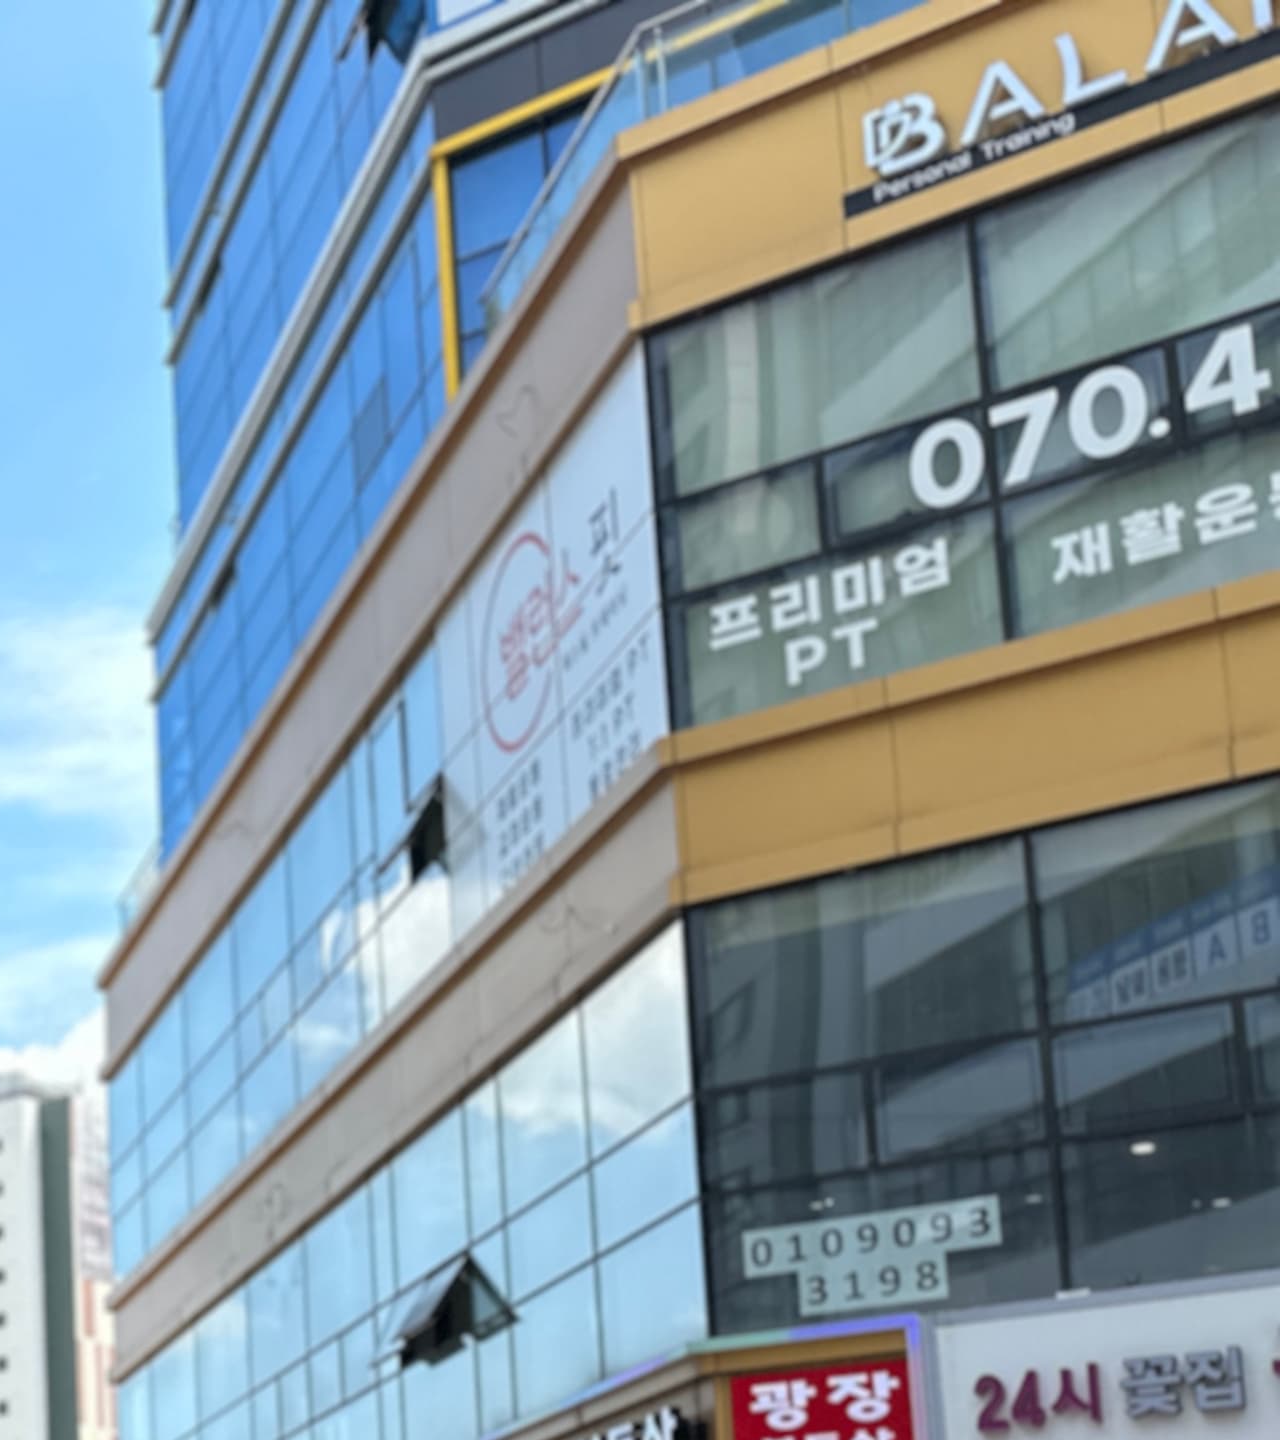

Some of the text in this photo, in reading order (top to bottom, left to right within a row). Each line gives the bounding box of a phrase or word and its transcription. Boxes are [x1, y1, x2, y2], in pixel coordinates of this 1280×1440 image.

[873, 112, 1077, 203] Personal Training
[908, 322, 1272, 509] 070.4
[709, 537, 951, 651] 프리미엄
[785, 618, 878, 686] PT
[807, 1261, 940, 1306] 3198
[749, 1369, 900, 1431] 광장
[974, 1345, 1246, 1432] 24시 꽃집
